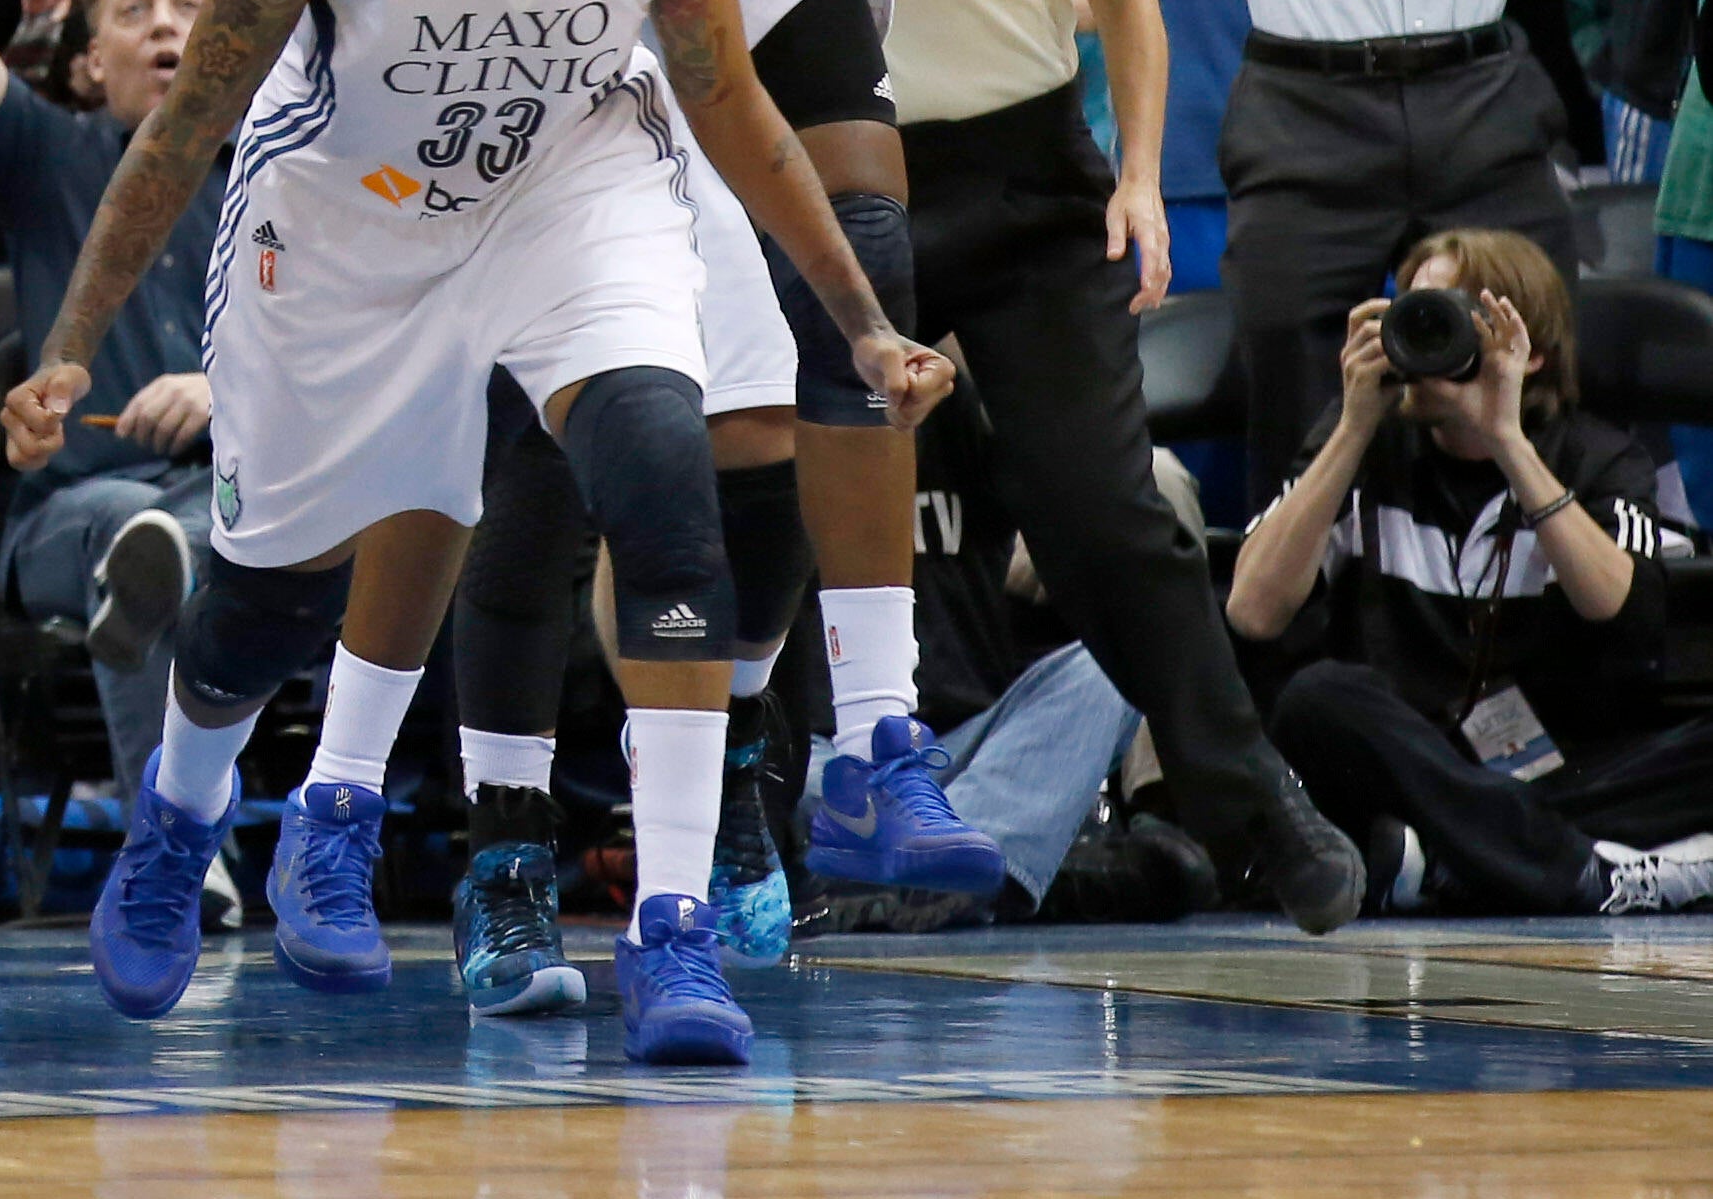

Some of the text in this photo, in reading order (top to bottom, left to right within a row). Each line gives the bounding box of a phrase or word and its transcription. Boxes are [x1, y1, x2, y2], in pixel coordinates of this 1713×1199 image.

[409, 0, 609, 52] MAYO
[382, 47, 619, 96] CLINIC
[416, 97, 546, 184] 33
